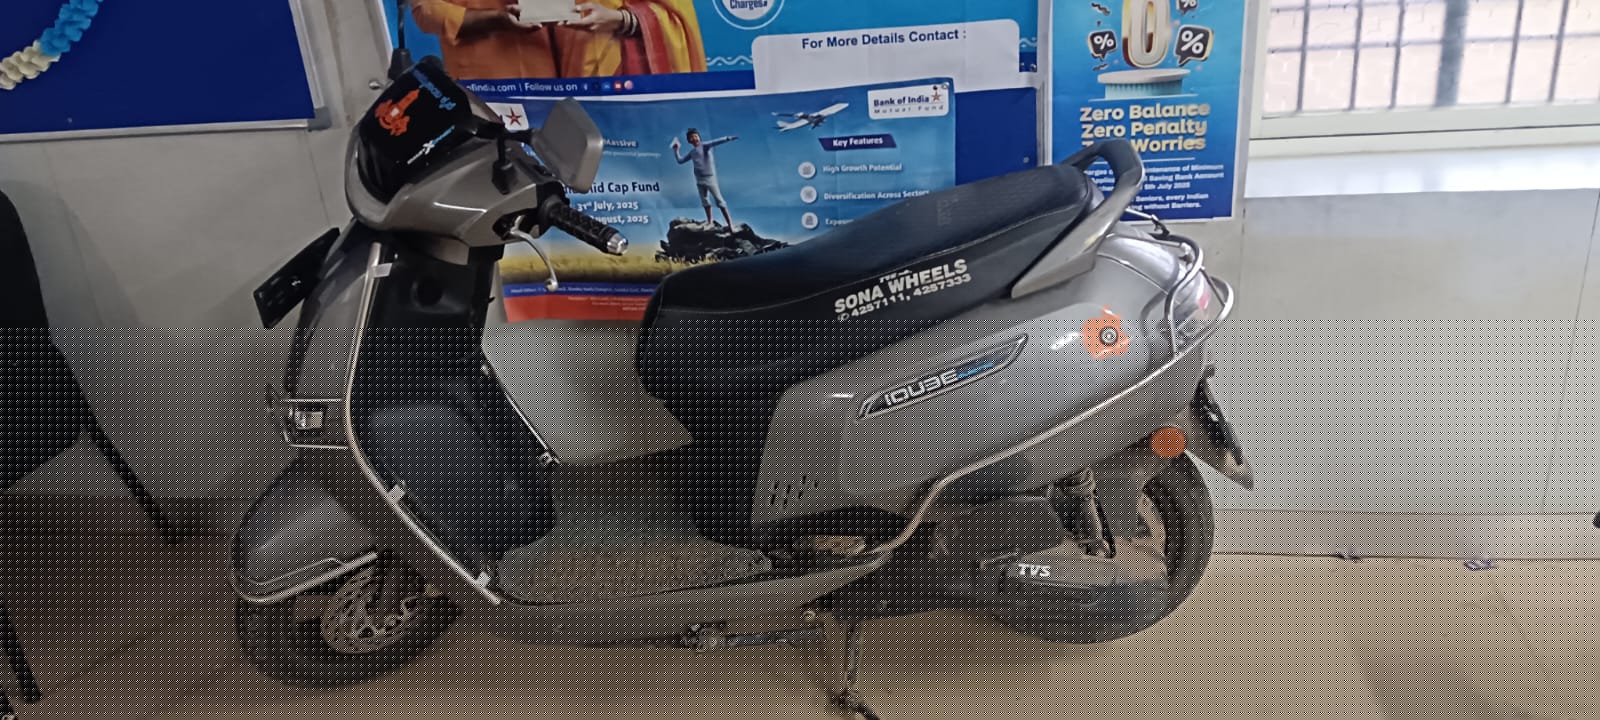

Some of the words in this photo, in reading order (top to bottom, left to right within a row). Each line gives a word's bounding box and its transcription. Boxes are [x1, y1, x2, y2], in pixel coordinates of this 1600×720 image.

[802, 38, 823, 50] For
[827, 35, 858, 48] More
[862, 32, 905, 45] Details
[909, 28, 959, 43] Contact
[525, 82, 551, 92] Follow
[874, 98, 895, 107] Bank
[897, 96, 906, 104] of
[908, 95, 930, 103] India
[1080, 107, 1125, 122] Zero
[1129, 102, 1211, 120] Balance
[1081, 122, 1127, 139] Zero
[1130, 119, 1209, 138] Penalty
[832, 138, 848, 148] Key
[850, 136, 884, 146] Features
[1131, 135, 1206, 153] Worries
[823, 164, 840, 173] High
[841, 163, 868, 172] Growth
[869, 162, 902, 171] Potential
[607, 182, 629, 195] Cap
[631, 181, 660, 192] Fund
[824, 192, 876, 200] Diversification
[594, 200, 615, 211] July,
[617, 201, 639, 209] 2025
[626, 215, 649, 223] 2025
[835, 285, 884, 313] SONA
[888, 259, 968, 294] WHEELS
[913, 273, 972, 297] 4257333
[1018, 563, 1051, 577] TVS
